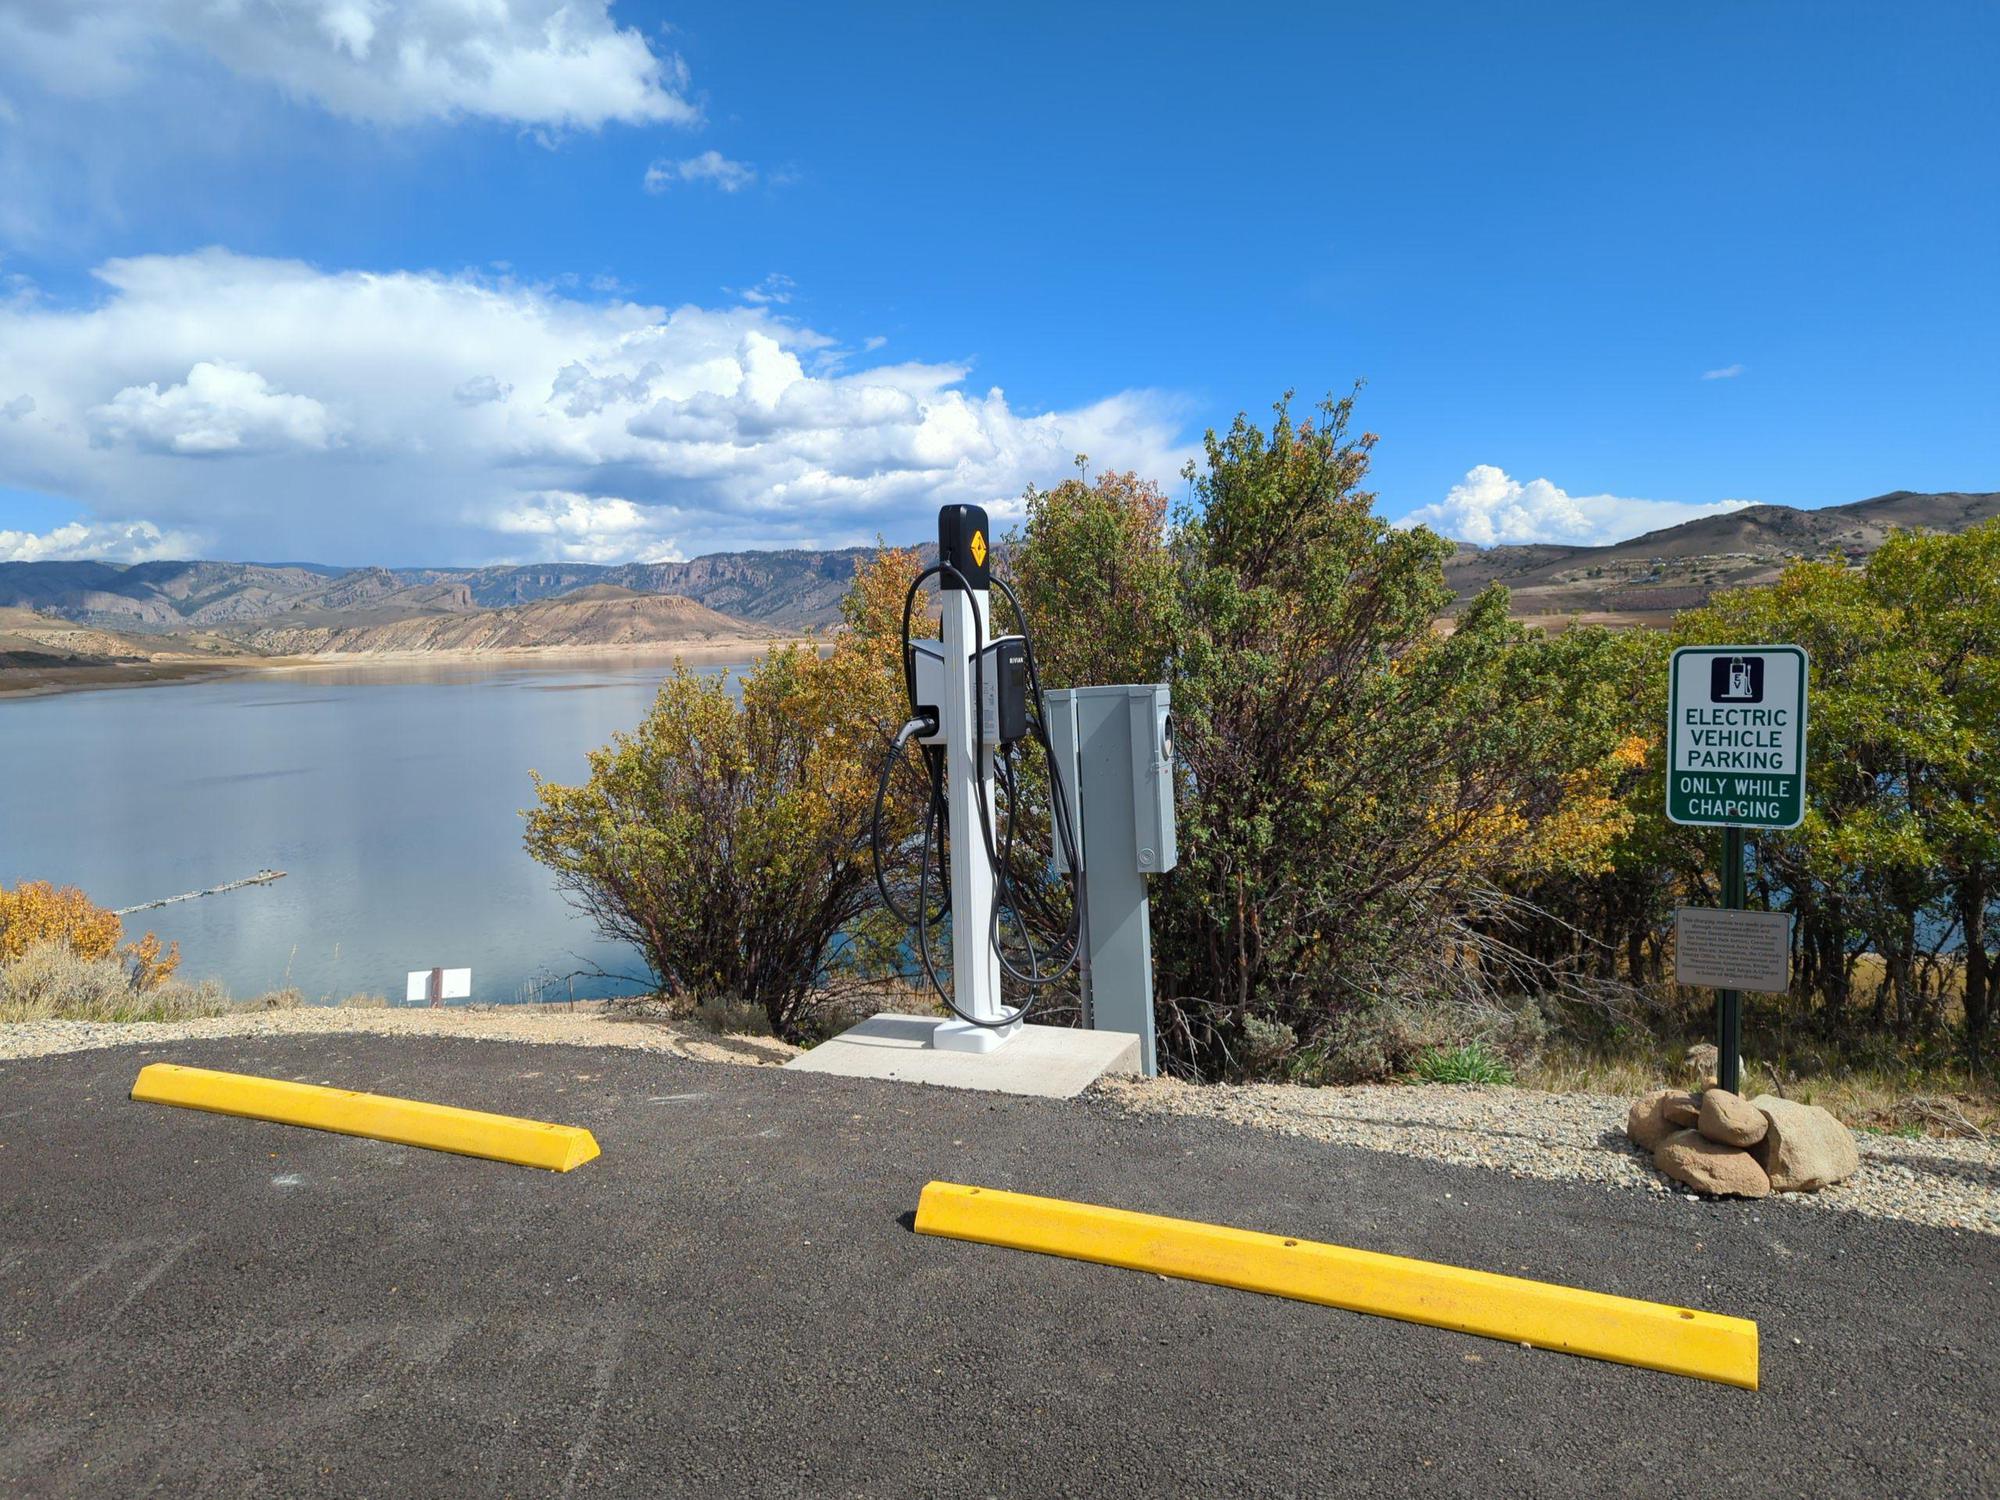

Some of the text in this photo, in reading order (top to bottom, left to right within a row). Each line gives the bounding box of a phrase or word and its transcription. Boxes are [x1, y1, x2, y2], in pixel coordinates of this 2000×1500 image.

[1686, 708, 1787, 727] ELECTRIC
[1690, 729, 1782, 748] VEHICLE
[1688, 750, 1783, 769] PARKING
[1680, 777, 1790, 798] ONLY WHILE
